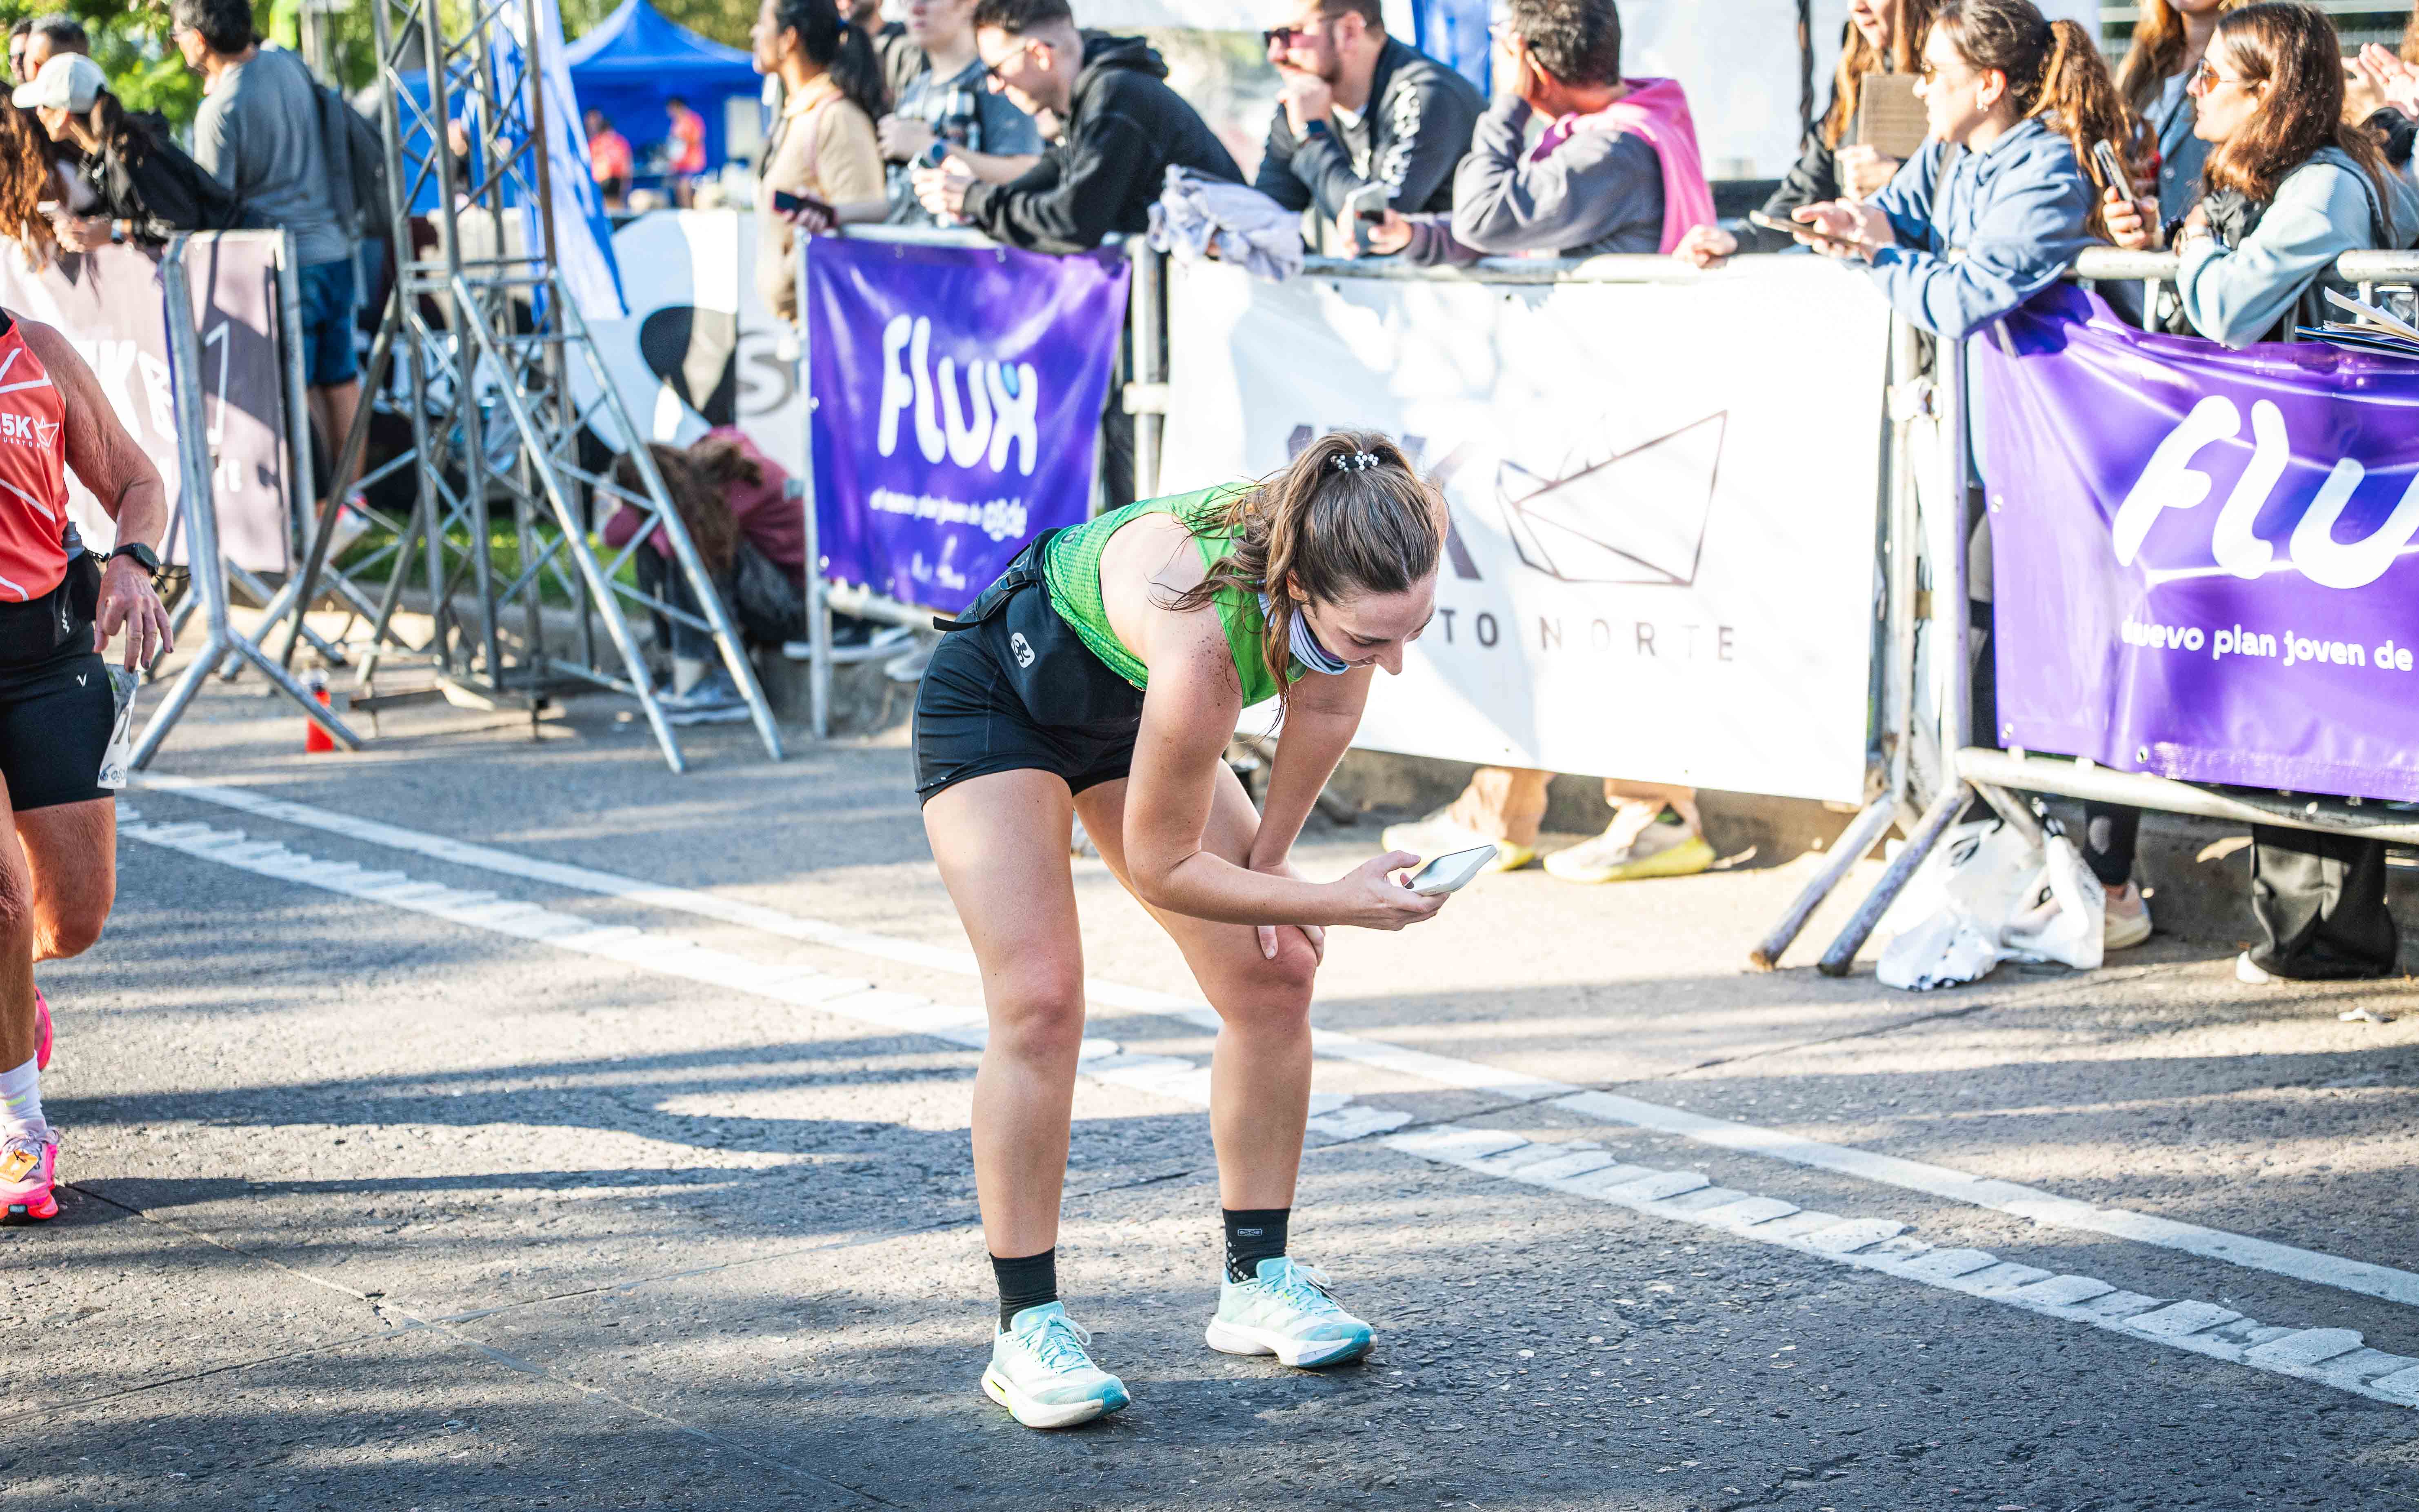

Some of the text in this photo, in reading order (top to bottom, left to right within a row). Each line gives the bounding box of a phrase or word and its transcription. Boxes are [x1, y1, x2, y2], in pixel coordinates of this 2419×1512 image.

[0, 412, 33, 440] 5K
[1539, 616, 1734, 662] NORTE
[2213, 624, 2277, 660] plan
[2283, 630, 2366, 666] joven
[2374, 639, 2413, 671] de
